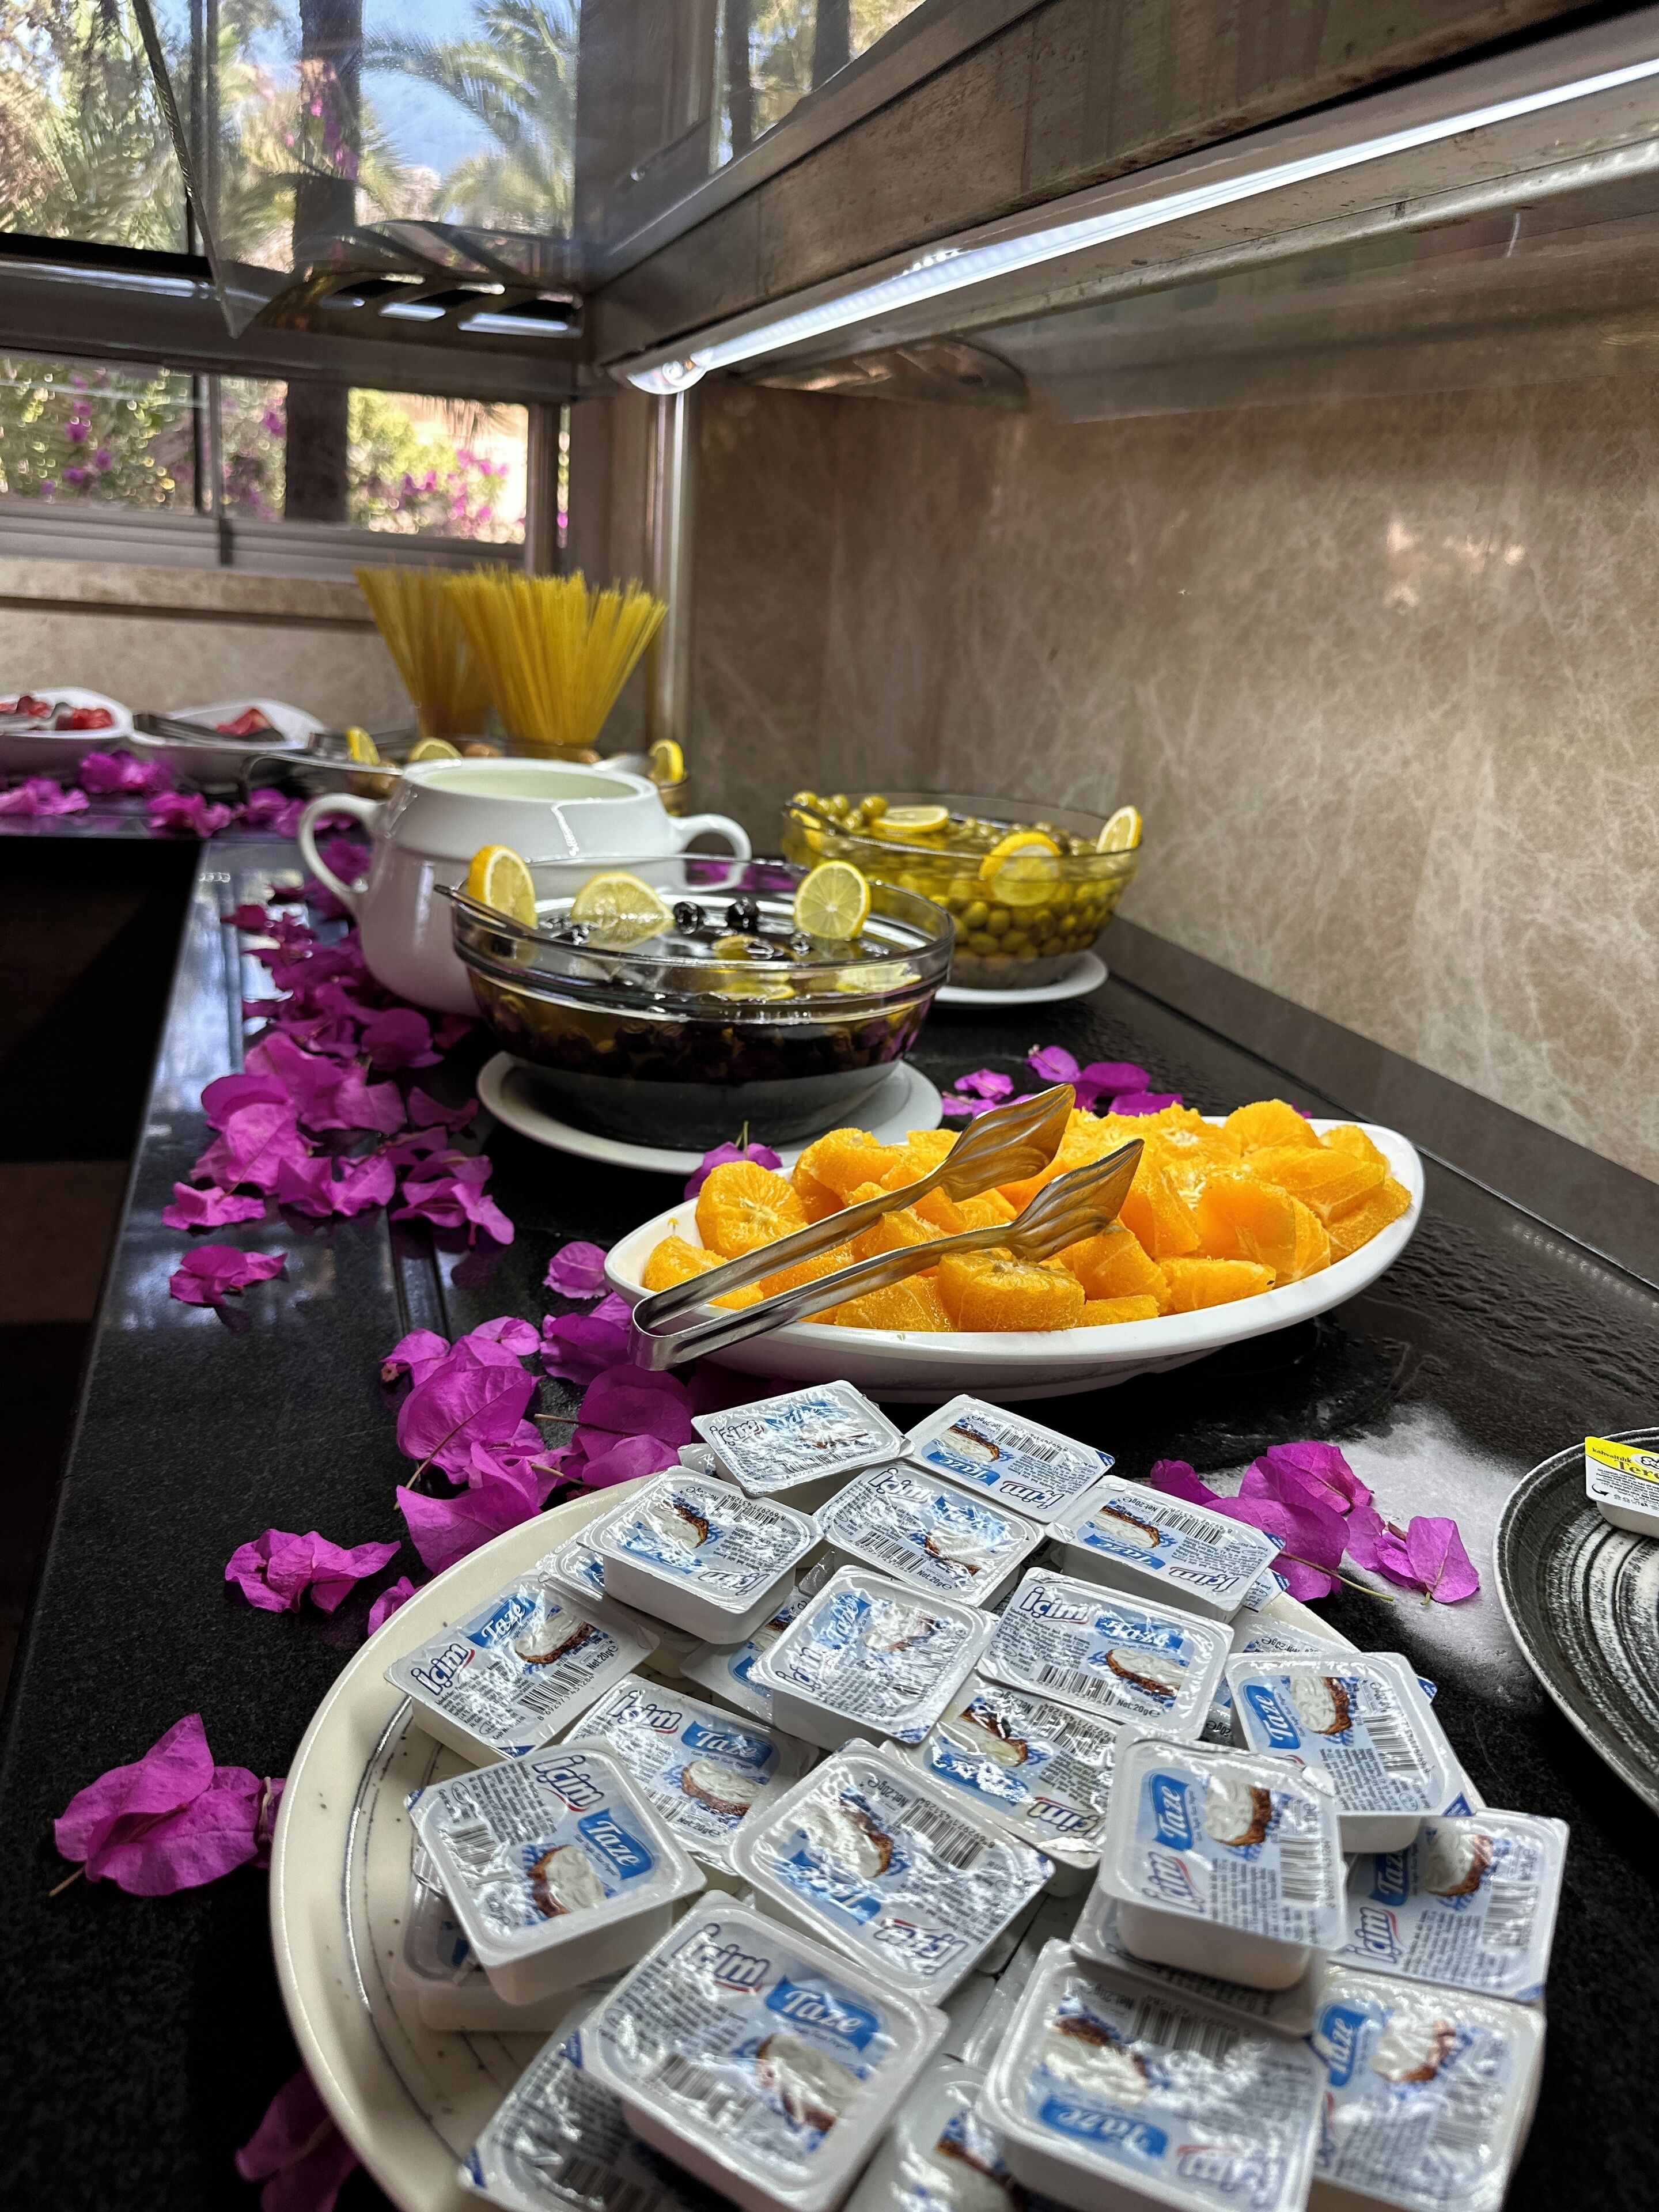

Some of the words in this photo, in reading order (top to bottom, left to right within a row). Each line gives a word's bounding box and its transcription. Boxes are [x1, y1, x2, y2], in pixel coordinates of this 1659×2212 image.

[938, 1457, 988, 1480] Taze
[999, 1482, 1065, 1510] İçim
[1097, 1541, 1152, 1565] Taze
[1169, 1569, 1240, 1592] İçim
[1020, 1586, 1089, 1620] İçim
[481, 1601, 526, 1642] Taze
[411, 1643, 469, 1696] İçim
[541, 1694, 572, 1715] 692971
[567, 1674, 597, 1695] 431284
[1041, 1703, 1075, 1723] 431284
[1077, 1718, 1109, 1739] 692971
[1255, 1694, 1294, 1743] Taze
[532, 1755, 605, 1806] İçim
[915, 1796, 953, 1821] 431284
[1159, 1784, 1188, 1837] Taze
[586, 1819, 639, 1866] Taze
[950, 1817, 988, 1843] 692971
[784, 1990, 863, 2035] Taze
